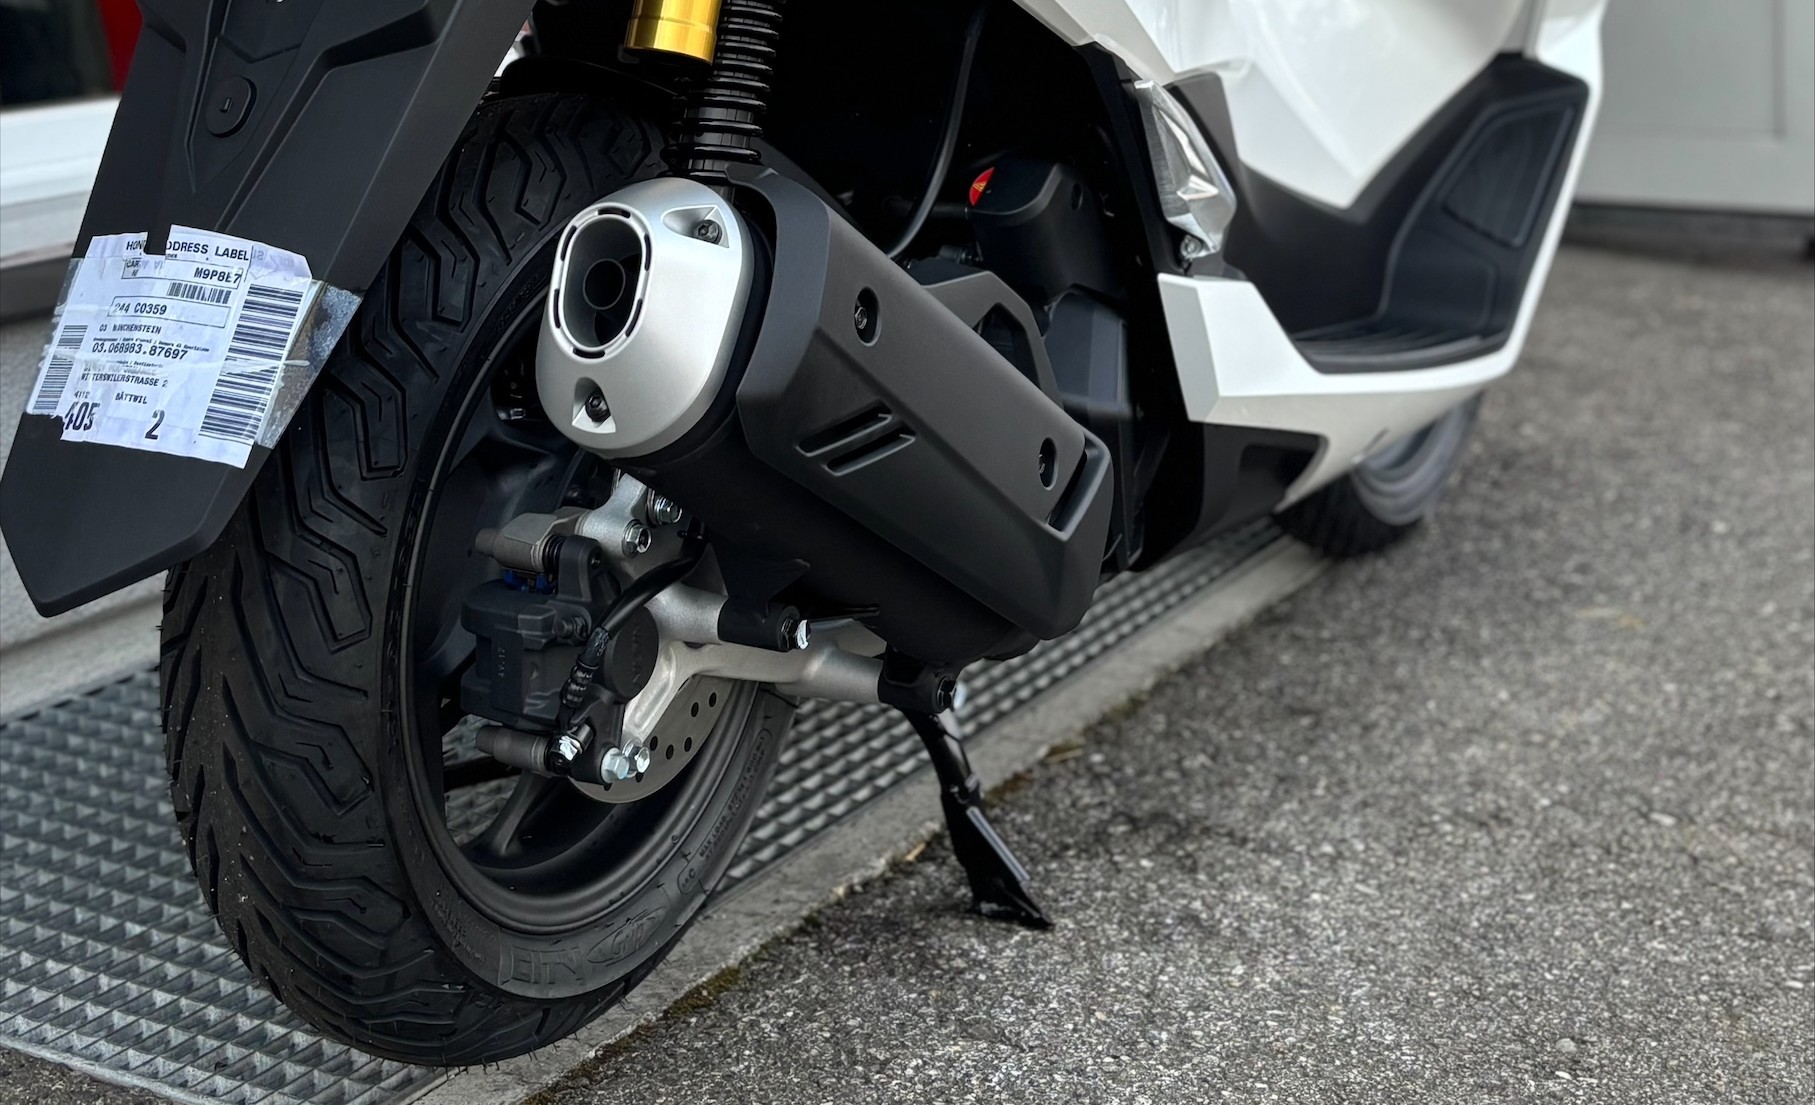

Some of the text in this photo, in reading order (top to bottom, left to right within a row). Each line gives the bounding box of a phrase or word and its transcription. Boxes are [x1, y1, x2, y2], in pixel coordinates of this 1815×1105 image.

[126, 240, 146, 250] HON
[166, 240, 208, 255] DDRESS
[215, 245, 249, 261] LABEL
[145, 409, 165, 440] 2
